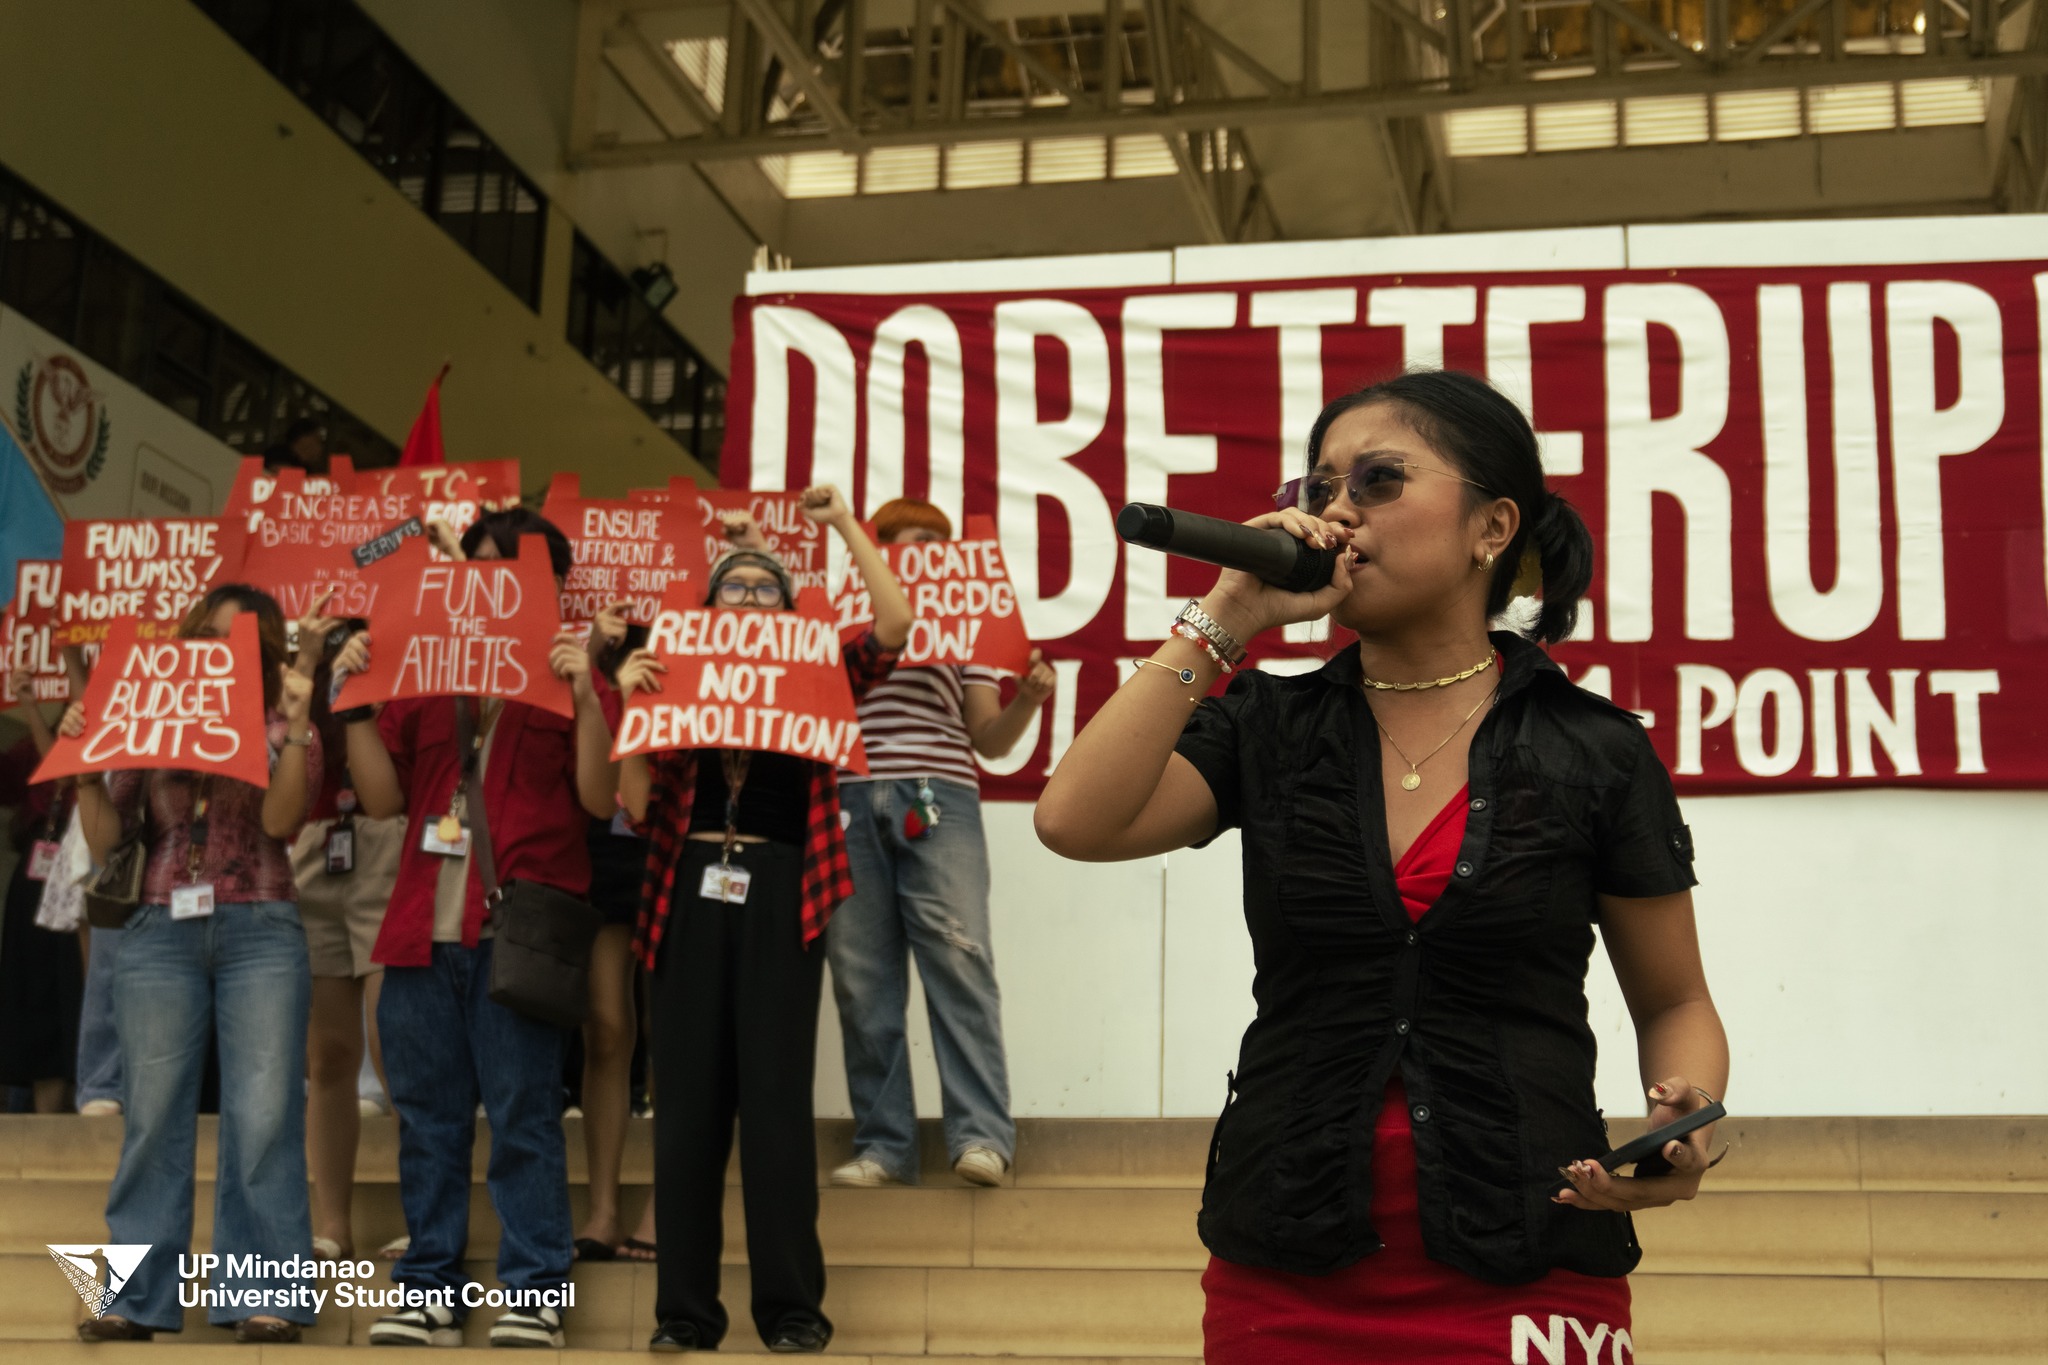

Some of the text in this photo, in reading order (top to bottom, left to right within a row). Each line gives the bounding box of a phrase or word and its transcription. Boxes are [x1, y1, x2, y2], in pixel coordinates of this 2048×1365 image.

[749, 304, 966, 606] DO
[1757, 281, 2005, 642] UP
[279, 493, 412, 521] INCREASE
[583, 507, 663, 541] ENSURE
[86, 521, 161, 560] FUND
[164, 521, 219, 557] THE
[261, 518, 314, 548] BASIC
[568, 538, 655, 566] UFFICIENT
[18, 562, 63, 618] FU
[98, 556, 223, 592] HUMSS!
[415, 567, 522, 620] FUND
[449, 616, 488, 636] THE
[646, 607, 841, 667] RELOCATION
[899, 618, 982, 662] OW!
[122, 643, 181, 679] NO
[184, 640, 235, 677] TO
[391, 634, 529, 697] ATHLETES
[103, 678, 236, 722] BUDGET
[699, 661, 787, 706] NOT
[81, 718, 241, 763] CUTS
[617, 704, 862, 769] DEMOLITION!
